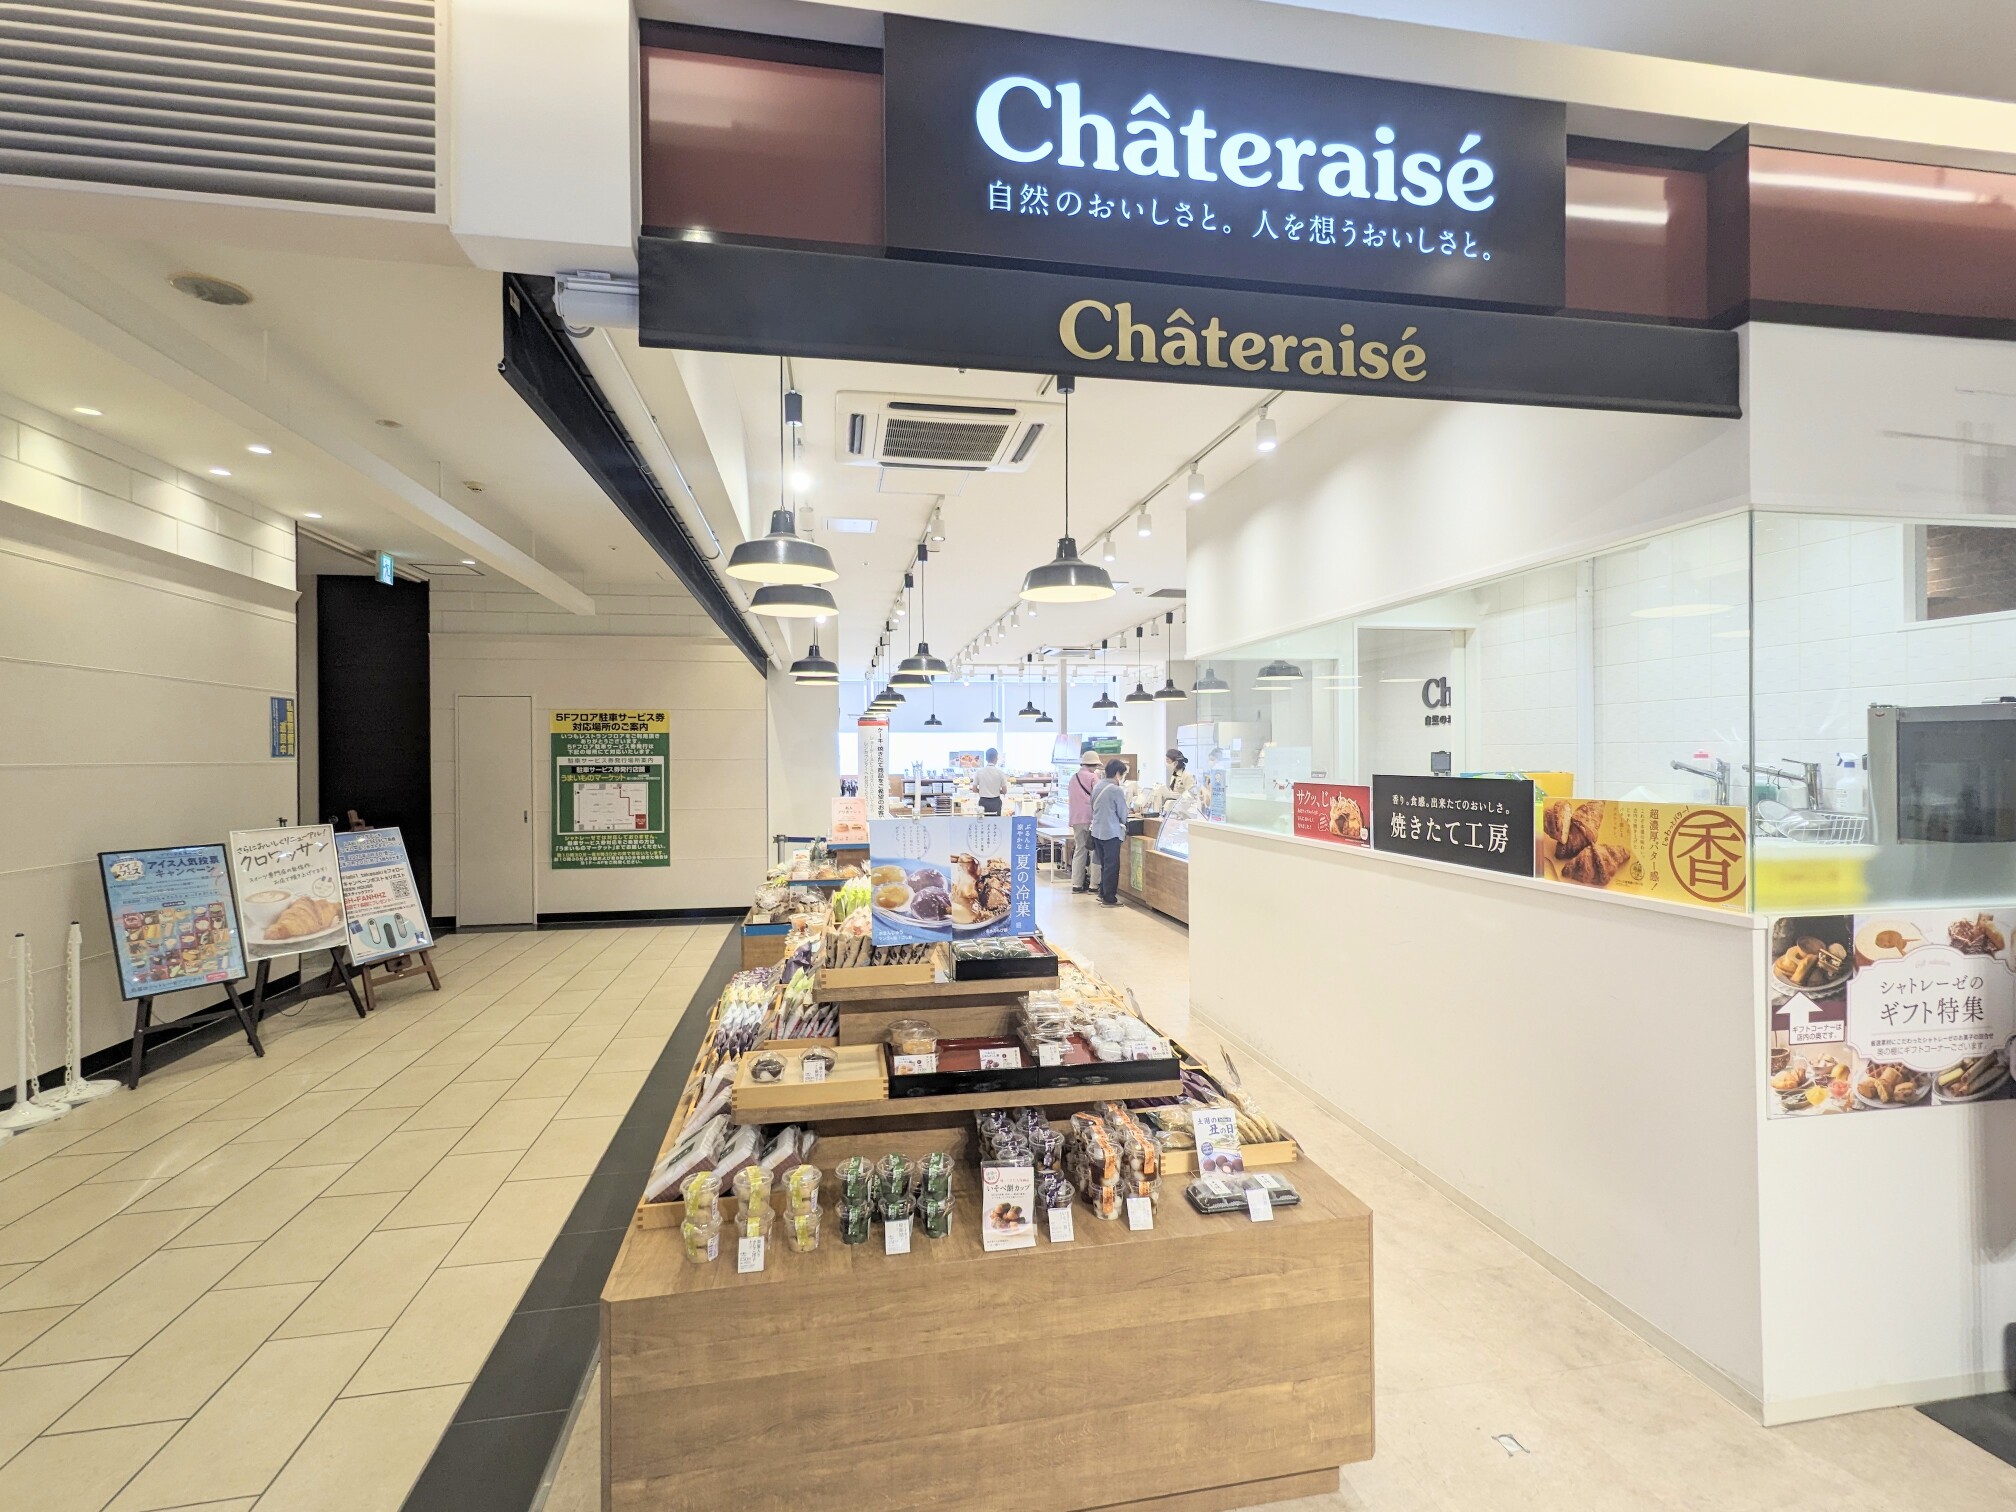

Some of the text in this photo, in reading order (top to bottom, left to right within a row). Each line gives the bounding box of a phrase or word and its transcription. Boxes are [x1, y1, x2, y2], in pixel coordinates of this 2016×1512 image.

[975, 77, 1494, 212] Châteraisé
[988, 181, 1491, 261] 自然のおいしさと。人を想うおいしさと。
[1059, 300, 1427, 382] Châteraisé
[556, 713, 665, 722] 5Fフロア駐車サービス券
[573, 722, 649, 731] 対応場所のご案内
[1392, 794, 1510, 815] 香り。食感。出来たてのおいしさ。
[1390, 812, 1509, 854] 焼きたて工房
[147, 855, 220, 870] アイス人気投票
[240, 842, 329, 872] クロワッサン
[1676, 818, 1743, 892] 香
[155, 865, 216, 878] キャンペーン
[1016, 854, 1031, 917] 夏の冷菓
[1880, 975, 1984, 995] シャトレーゼの
[1880, 996, 1985, 1026] ギフト特集
[1792, 1023, 1842, 1034] ギフトコーナーは
[1796, 1031, 1837, 1041] 店内の奥です。
[1209, 1124, 1234, 1136] 丑の日
